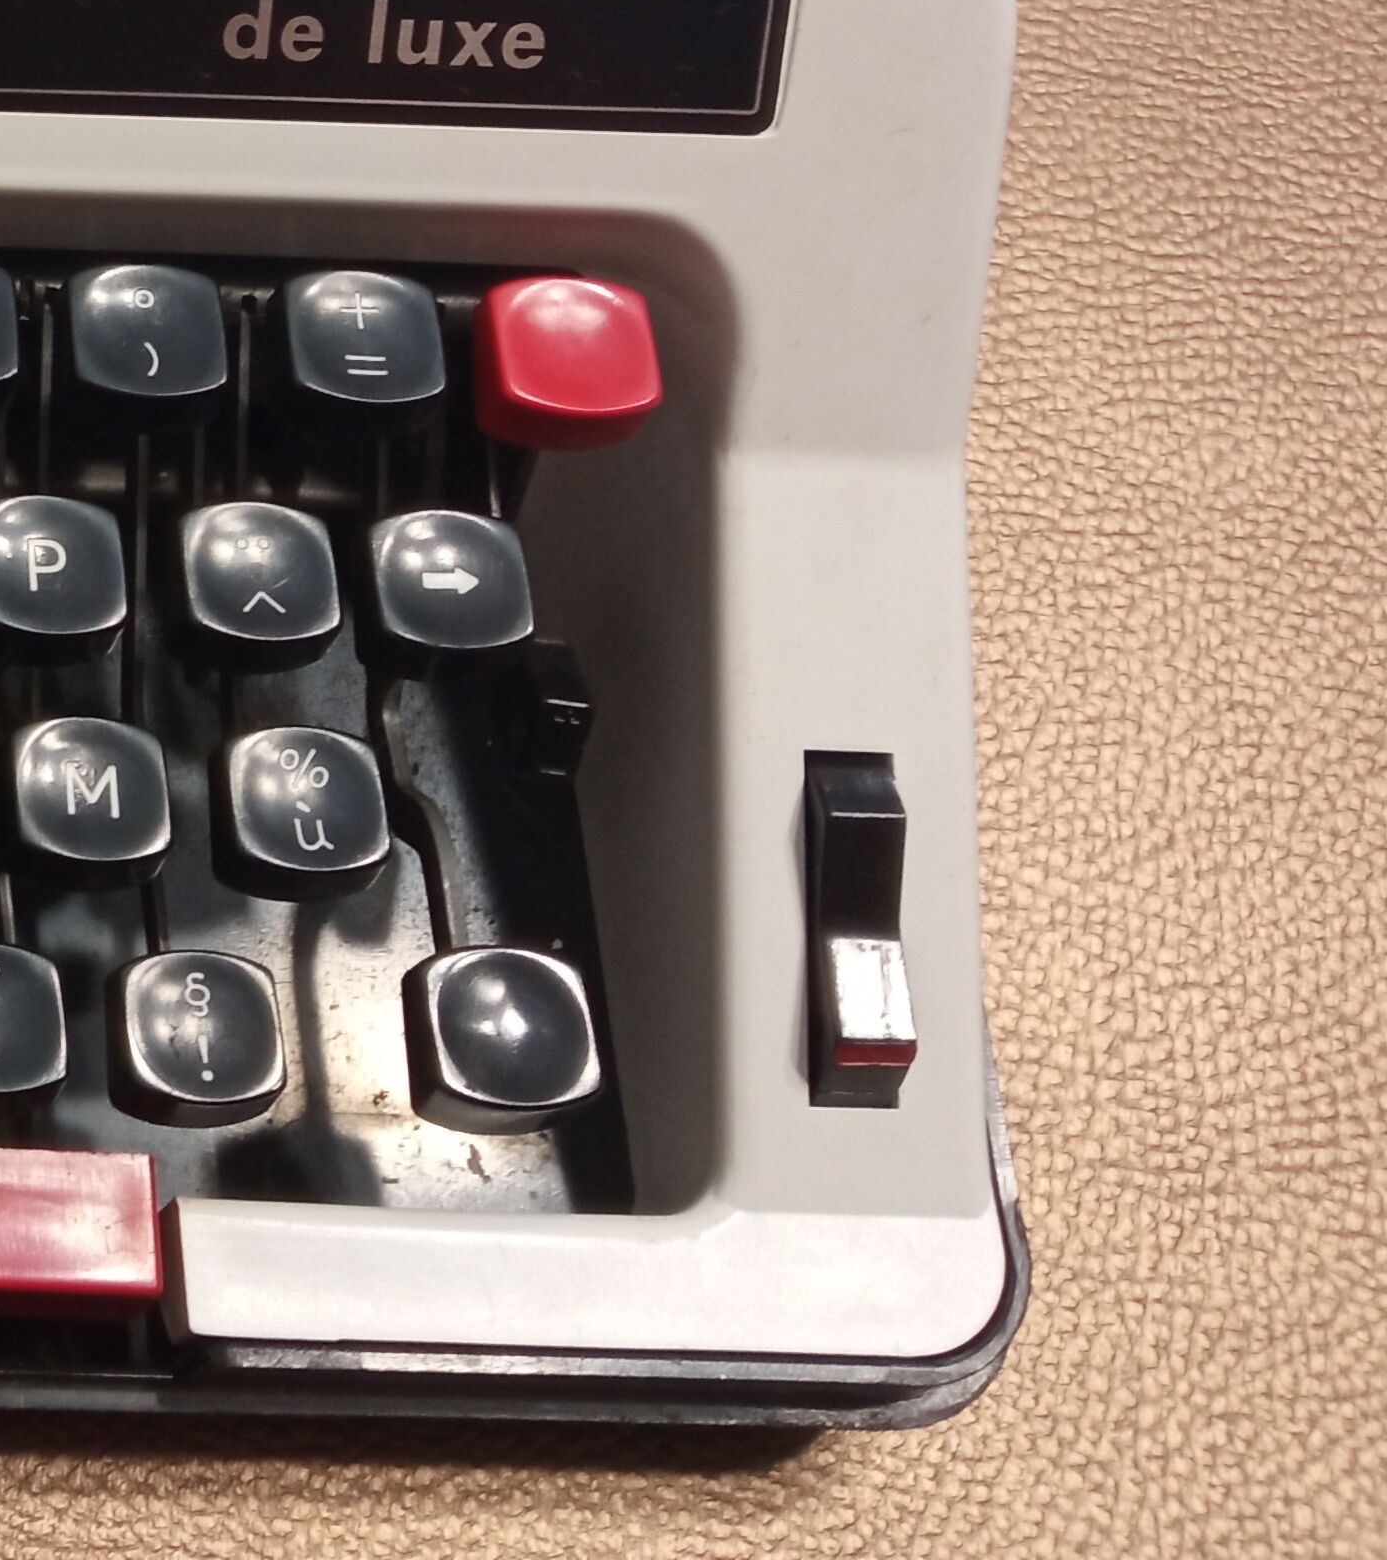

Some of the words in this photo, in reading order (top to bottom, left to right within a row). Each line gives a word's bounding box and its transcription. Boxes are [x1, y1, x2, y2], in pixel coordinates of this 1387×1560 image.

[340, 293, 379, 329] +
[145, 343, 158, 376] )
[345, 355, 388, 375] =
[28, 539, 66, 591] P
[65, 761, 119, 818] M
[280, 748, 329, 789] %
[294, 800, 333, 850] ù
[185, 972, 211, 1017] §
[198, 1034, 214, 1081] !
